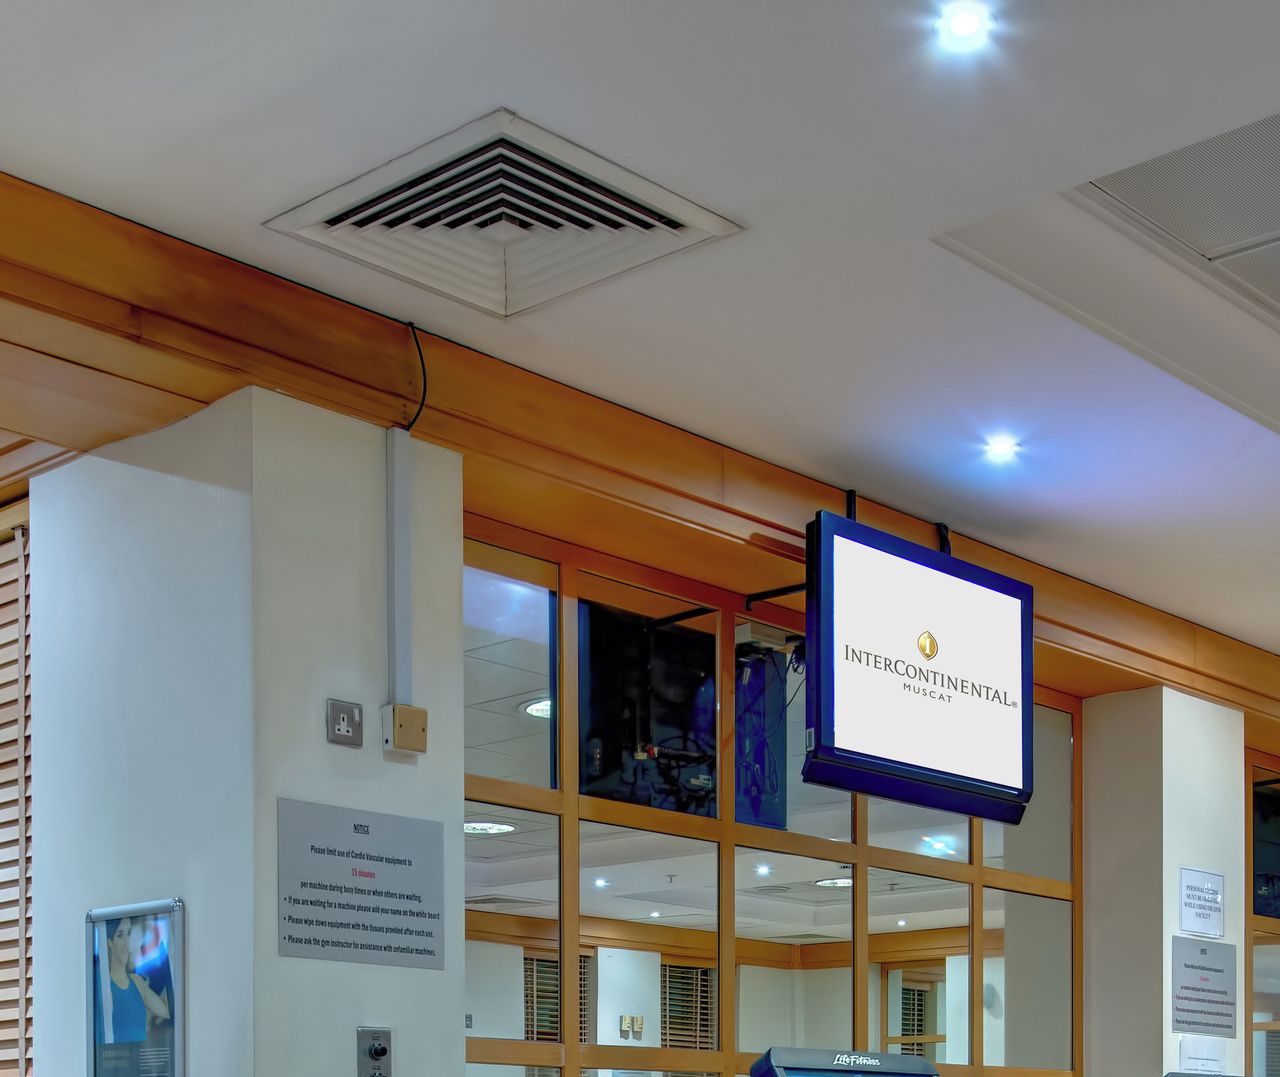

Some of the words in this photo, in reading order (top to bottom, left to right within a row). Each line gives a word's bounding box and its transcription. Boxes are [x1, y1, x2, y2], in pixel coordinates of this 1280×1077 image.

[903, 683, 952, 703] MUSCAT
[353, 823, 370, 835] NOTICE
[311, 844, 326, 855] Please
[326, 847, 337, 856] limit
[337, 850, 345, 858] use
[346, 850, 351, 858] of
[351, 850, 366, 860] Cardio
[366, 852, 384, 863] Vascular
[385, 856, 407, 866] equipment
[408, 859, 412, 867] to
[358, 870, 375, 879] minutes
[309, 882, 328, 891] machine
[329, 884, 343, 894] during
[344, 885, 353, 894] busy
[354, 886, 366, 895] times
[372, 889, 383, 897] when
[384, 890, 398, 899] others
[288, 896, 292, 904] If
[310, 899, 326, 909] waiting
[338, 902, 356, 911] machine
[357, 904, 371, 912] please
[372, 905, 380, 913] add
[381, 907, 389, 915] your
[390, 908, 401, 916] name
[416, 910, 427, 918] white
[288, 915, 303, 925] Please
[304, 917, 314, 927] wipe
[315, 918, 327, 927] down
[328, 920, 351, 931] equipment
[352, 922, 361, 930] with
[369, 925, 384, 933] tissues
[385, 926, 403, 935] provided
[404, 927, 414, 936] after
[415, 929, 425, 937] each
[288, 935, 303, 944] Please
[304, 937, 312, 945] ask
[321, 940, 330, 948] gym
[331, 939, 352, 949] instructor
[360, 942, 382, 952] assistance
[383, 944, 392, 953] with
[393, 945, 415, 954] unfamiliar
